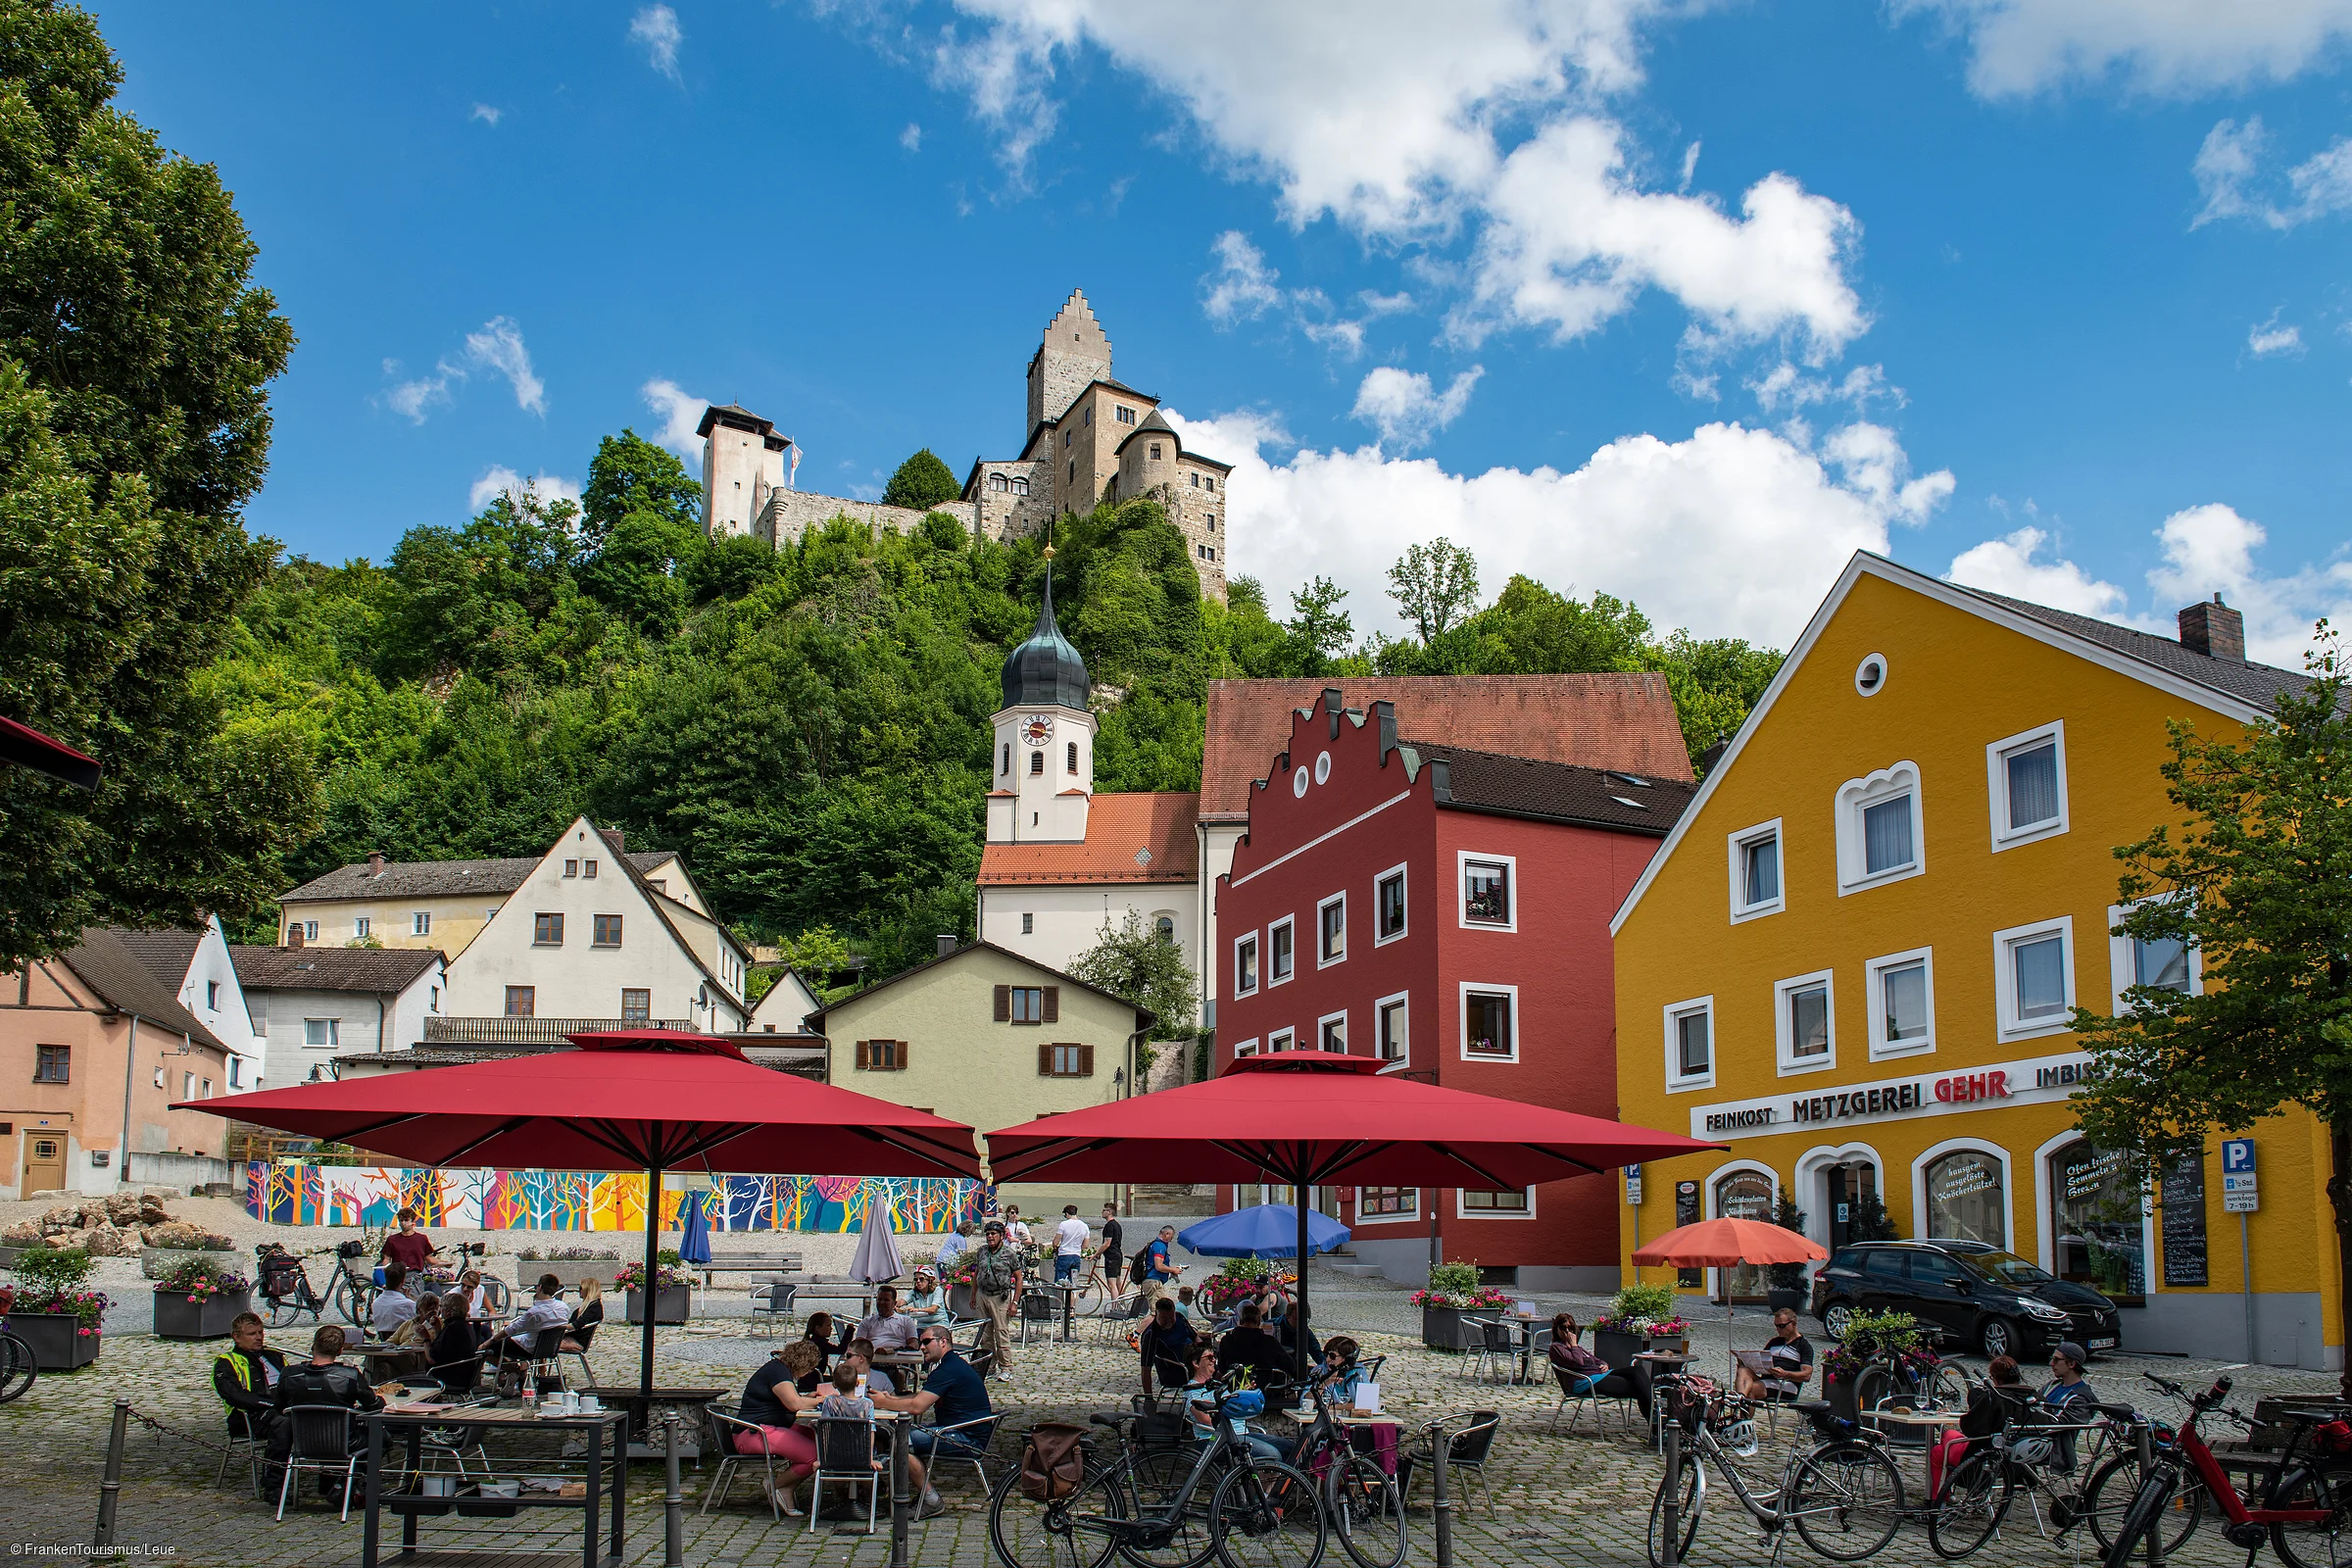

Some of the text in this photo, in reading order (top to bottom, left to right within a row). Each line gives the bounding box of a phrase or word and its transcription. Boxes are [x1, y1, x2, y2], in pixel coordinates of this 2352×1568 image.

[1705, 1107, 1772, 1132] FEINKOST
[1792, 1082, 1922, 1123] METZGEREI
[1934, 1070, 2009, 1102] GEHR
[2066, 1152, 2121, 1175] Ofen frische
[2229, 1143, 2247, 1169] P
[1948, 1161, 1984, 1177] hausgem.
[2067, 1165, 2109, 1186] Semmeln
[1945, 1171, 1985, 1188] ausgelöste
[2165, 1176, 2191, 1187] Gehr's
[1728, 1195, 1767, 1204] Schinkenplatten
